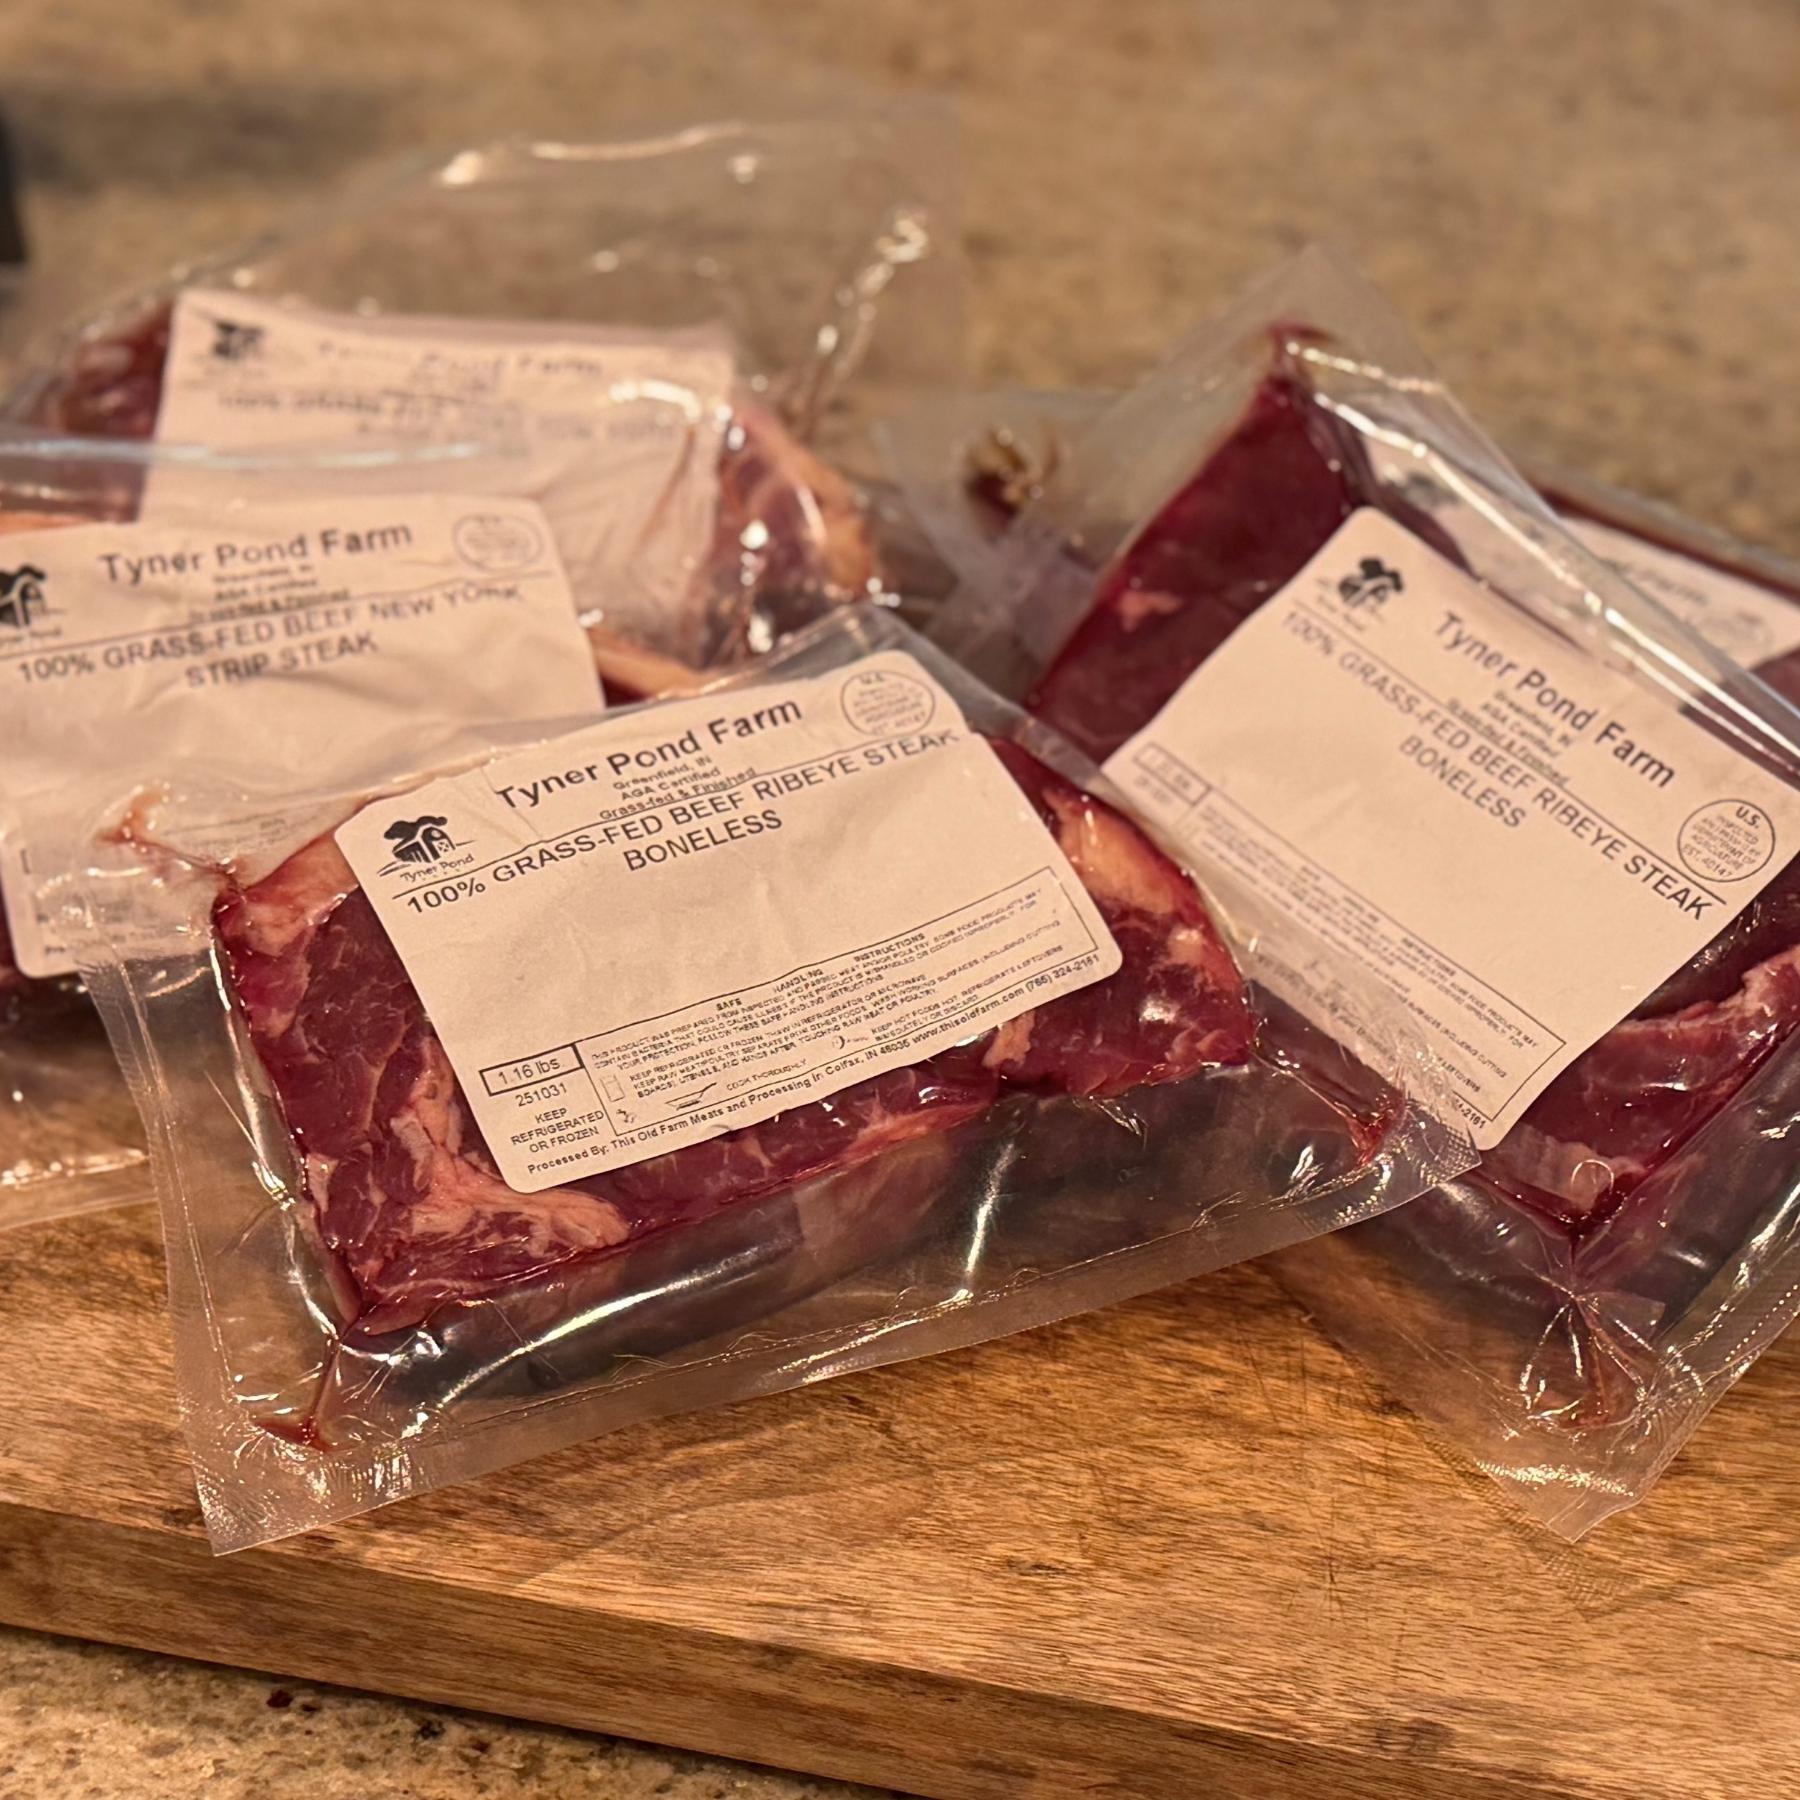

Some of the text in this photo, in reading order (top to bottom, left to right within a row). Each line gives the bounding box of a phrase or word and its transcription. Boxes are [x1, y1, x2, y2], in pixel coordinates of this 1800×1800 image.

[100, 553, 199, 585] Tyner
[215, 534, 307, 566] Pond
[320, 526, 411, 554] Farm
[19, 653, 95, 681] 100%
[104, 622, 274, 668] GRASS-FED
[283, 607, 353, 637] BEEF
[370, 597, 434, 618] NEW
[186, 633, 377, 685] STRIP STEAK
[1437, 613, 1518, 677] Tyner
[1516, 669, 1597, 730] Pond
[1595, 722, 1674, 787] Farm
[495, 765, 597, 807] Tyner
[607, 731, 701, 775] Pond
[708, 702, 801, 743] Farm
[622, 767, 720, 800] AGA Certified
[1340, 653, 1470, 749] GRASS-FED
[1469, 745, 1535, 788] BEEF
[1534, 788, 1626, 859] RIBEYE
[1624, 855, 1711, 919] STEAK
[1401, 736, 1525, 826] BONELESS
[408, 730, 957, 912] 100% GRASS-FED BEEF RIBEYE STEAK
[599, 793, 675, 820] Grass-fed
[1735, 806, 1760, 829] U.S.
[624, 810, 781, 870] BONELESS
[400, 866, 437, 882] Tyner
[439, 853, 474, 869] Pond
[854, 933, 925, 962] INSTRUCTIONS
[773, 969, 823, 993] HANDLING
[716, 997, 742, 1011] SAFE
[527, 1149, 588, 1173] Processed
[590, 1145, 609, 1155] By:
[610, 1137, 636, 1149] This
[637, 1128, 658, 1141] Old
[659, 1120, 688, 1134] Farm
[689, 1108, 724, 1125] Meats
[726, 1098, 747, 1112] and
[748, 1079, 811, 1104] Processing
[825, 1057, 864, 1075] Colfax,
[864, 1049, 878, 1060] IN
[912, 988, 1024, 1043] www.thisoldfarm.com
[629, 1069, 652, 1082] KEEP
[633, 1077, 655, 1089] KEEP
[515, 1082, 566, 1107] 251031
[511, 1110, 604, 1144] REFRIGERATED
[535, 1107, 567, 1123] KEEP
[529, 1126, 599, 1153] OR FROZEN
